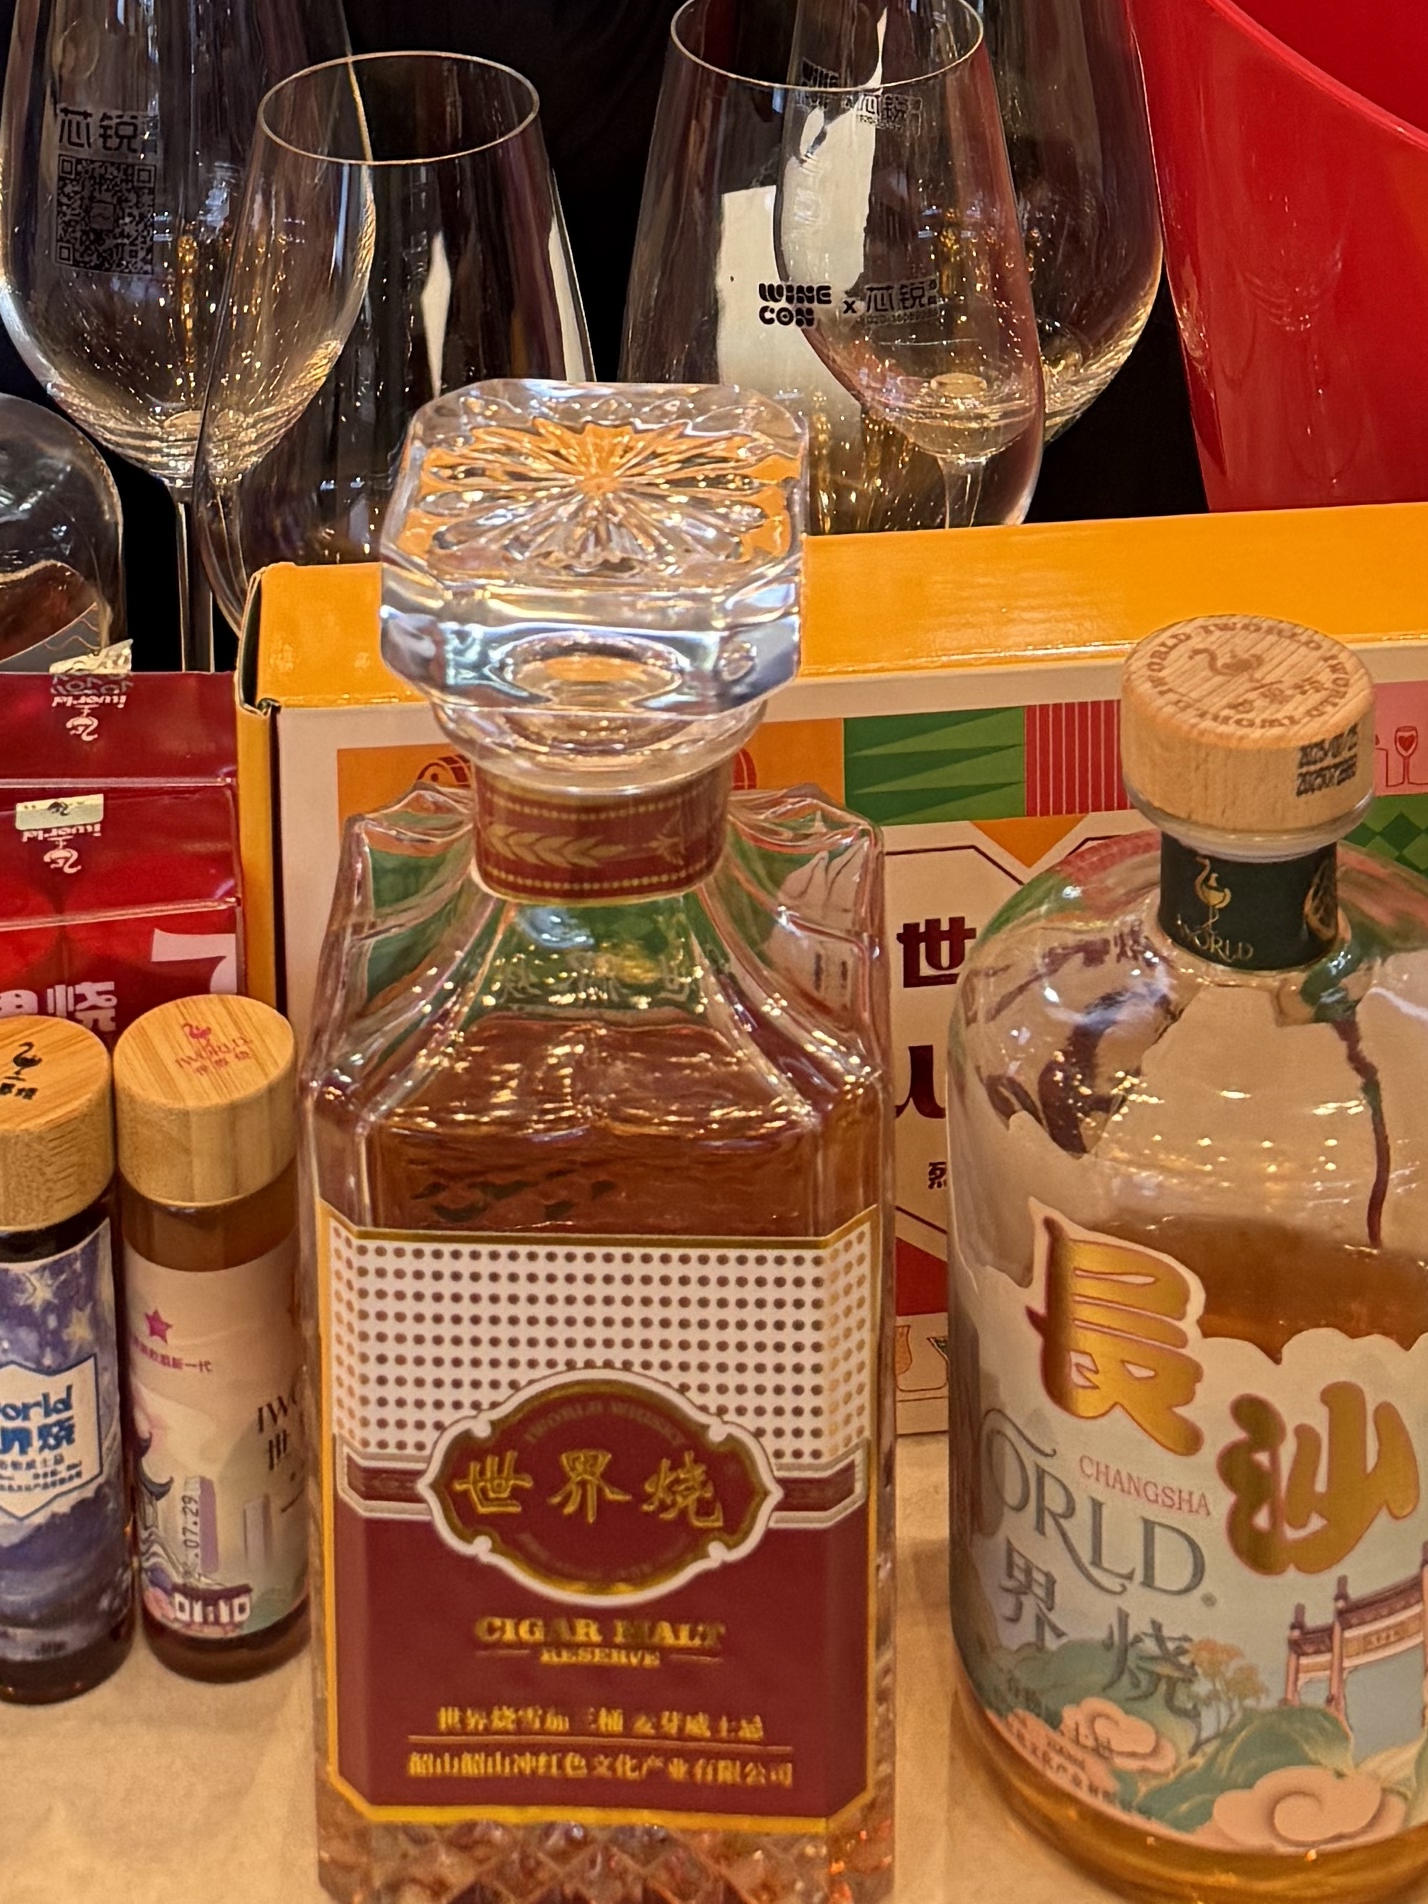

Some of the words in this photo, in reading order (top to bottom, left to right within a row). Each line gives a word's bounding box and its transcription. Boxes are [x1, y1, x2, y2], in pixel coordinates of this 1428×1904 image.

[758, 282, 833, 305] WINE
[1078, 1455, 1213, 1520] CHANGSHA
[474, 1616, 603, 1646] CIGAR
[613, 1618, 727, 1648] MALT
[538, 1647, 661, 1670] RESERVE
